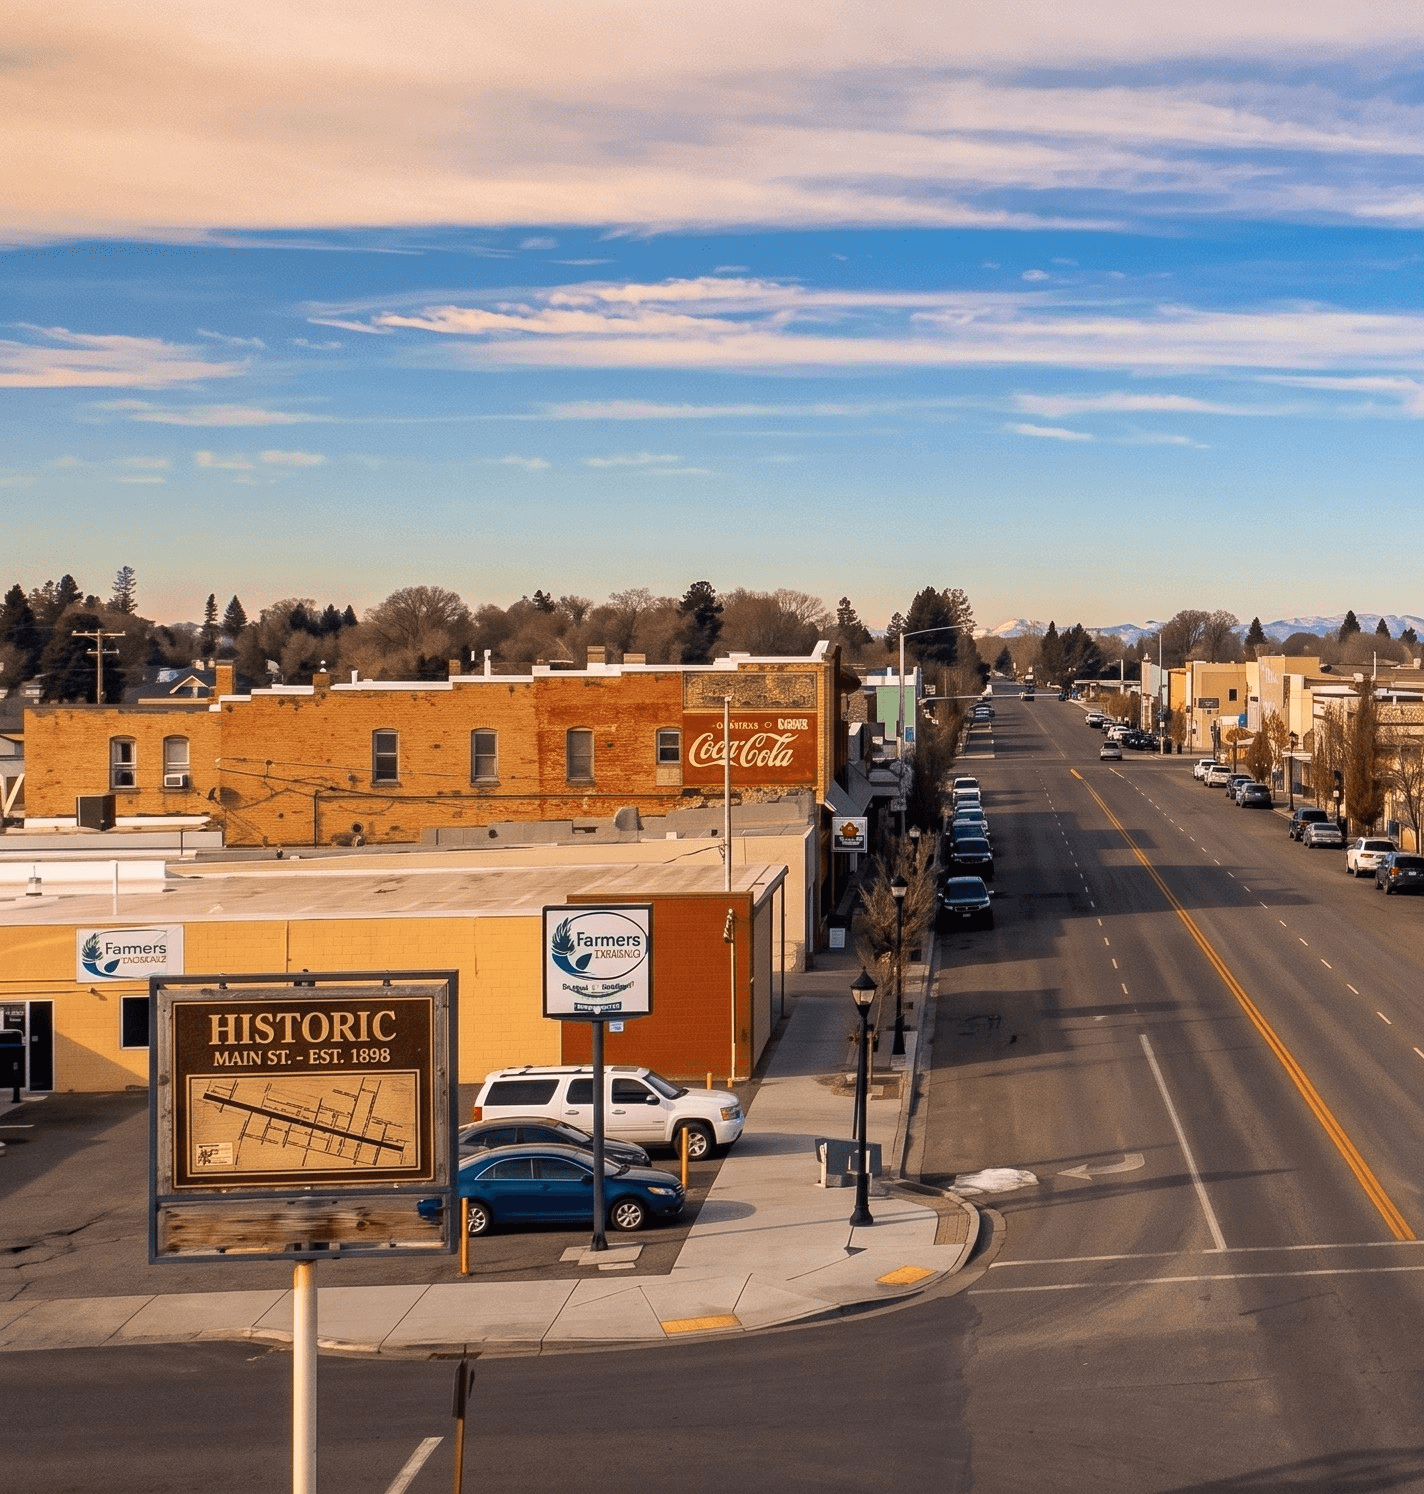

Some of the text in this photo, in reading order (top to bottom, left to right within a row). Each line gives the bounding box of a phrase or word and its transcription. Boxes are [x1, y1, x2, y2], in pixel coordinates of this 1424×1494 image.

[576, 932, 641, 947] Farmers
[208, 1010, 397, 1046] HISTORIC
[213, 1050, 263, 1066] MAIN
[267, 1049, 292, 1065] ST.
[308, 1048, 345, 1064] EST.
[351, 1048, 391, 1063] 1898
